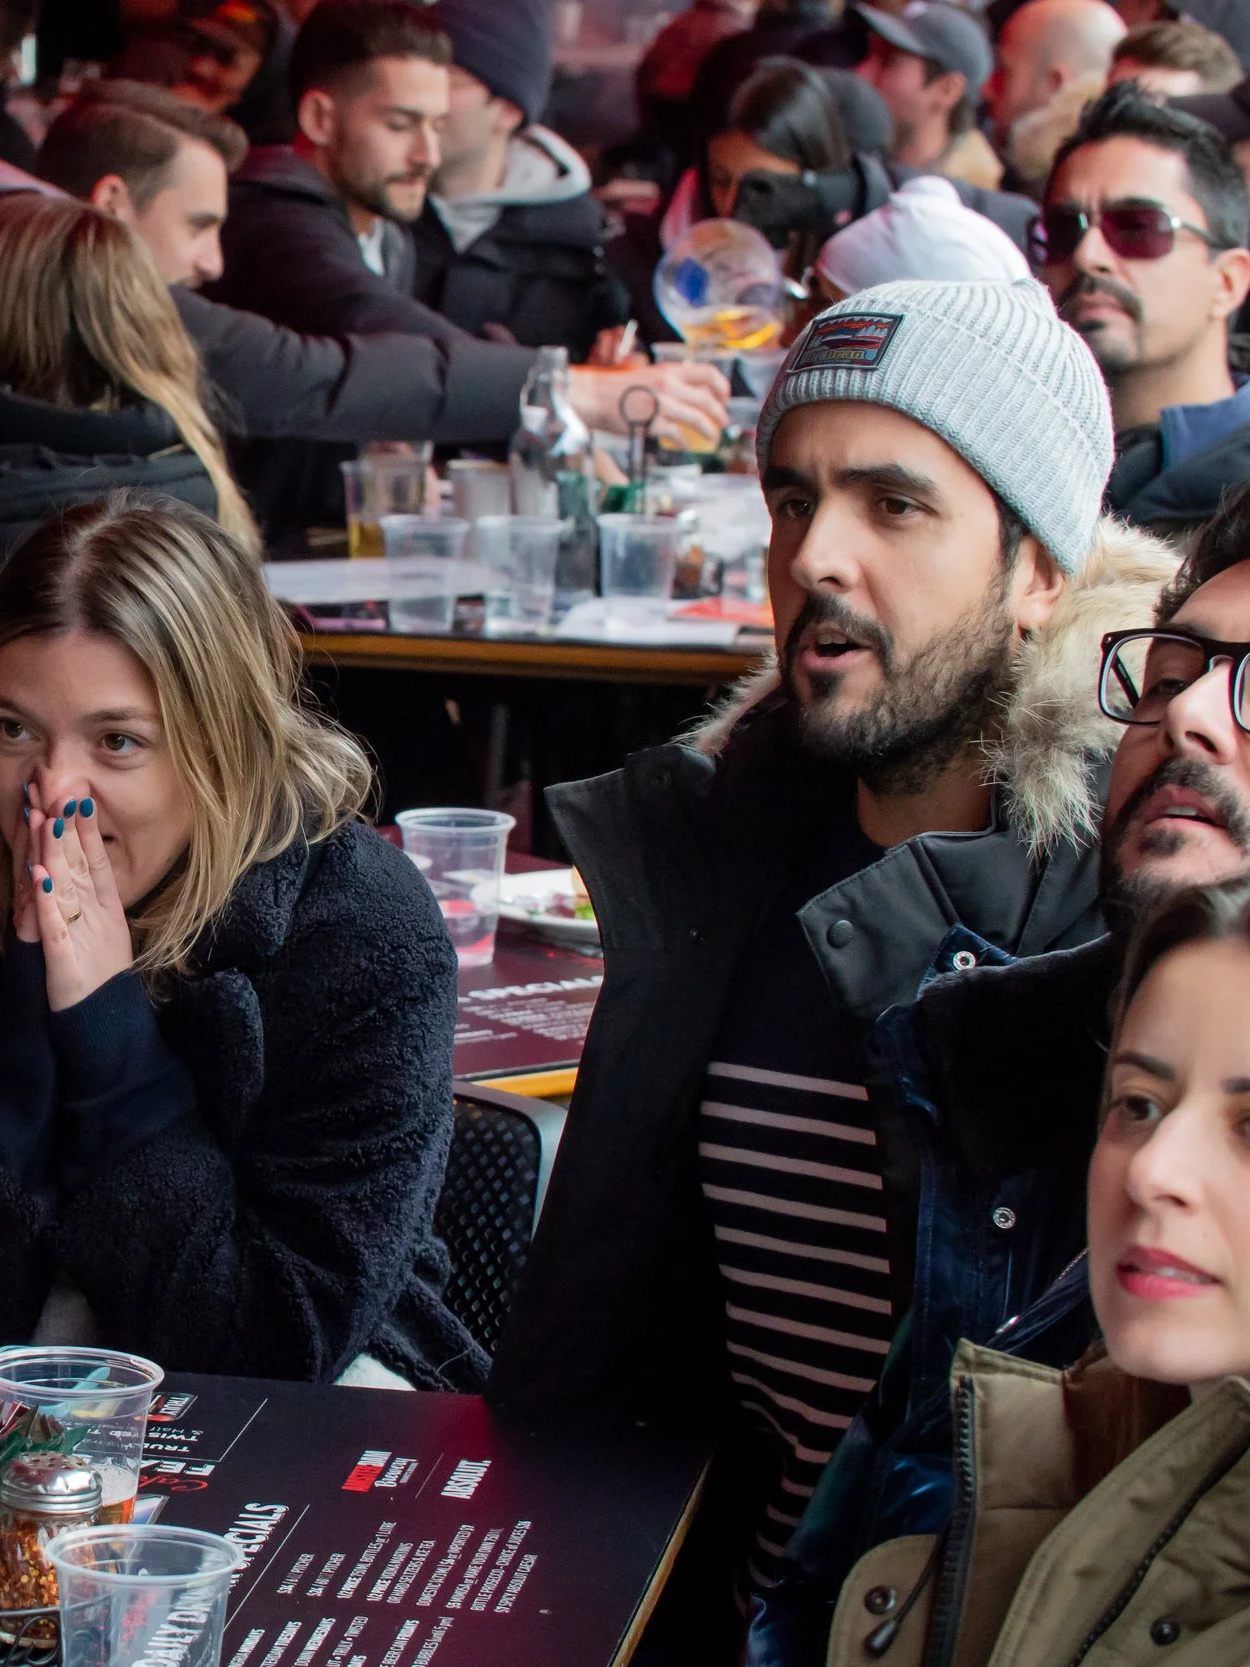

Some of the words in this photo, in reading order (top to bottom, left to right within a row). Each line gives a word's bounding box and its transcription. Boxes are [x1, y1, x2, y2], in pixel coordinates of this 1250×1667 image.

[291, 1554, 314, 1573] PITCHER
[321, 1553, 345, 1573] PITCHER
[238, 1629, 265, 1653] MONDAYS
[274, 1622, 302, 1646] TUESDAYS
[304, 1618, 336, 1650] WEDNESDAYS
[396, 1620, 419, 1640] FRIDAYS
